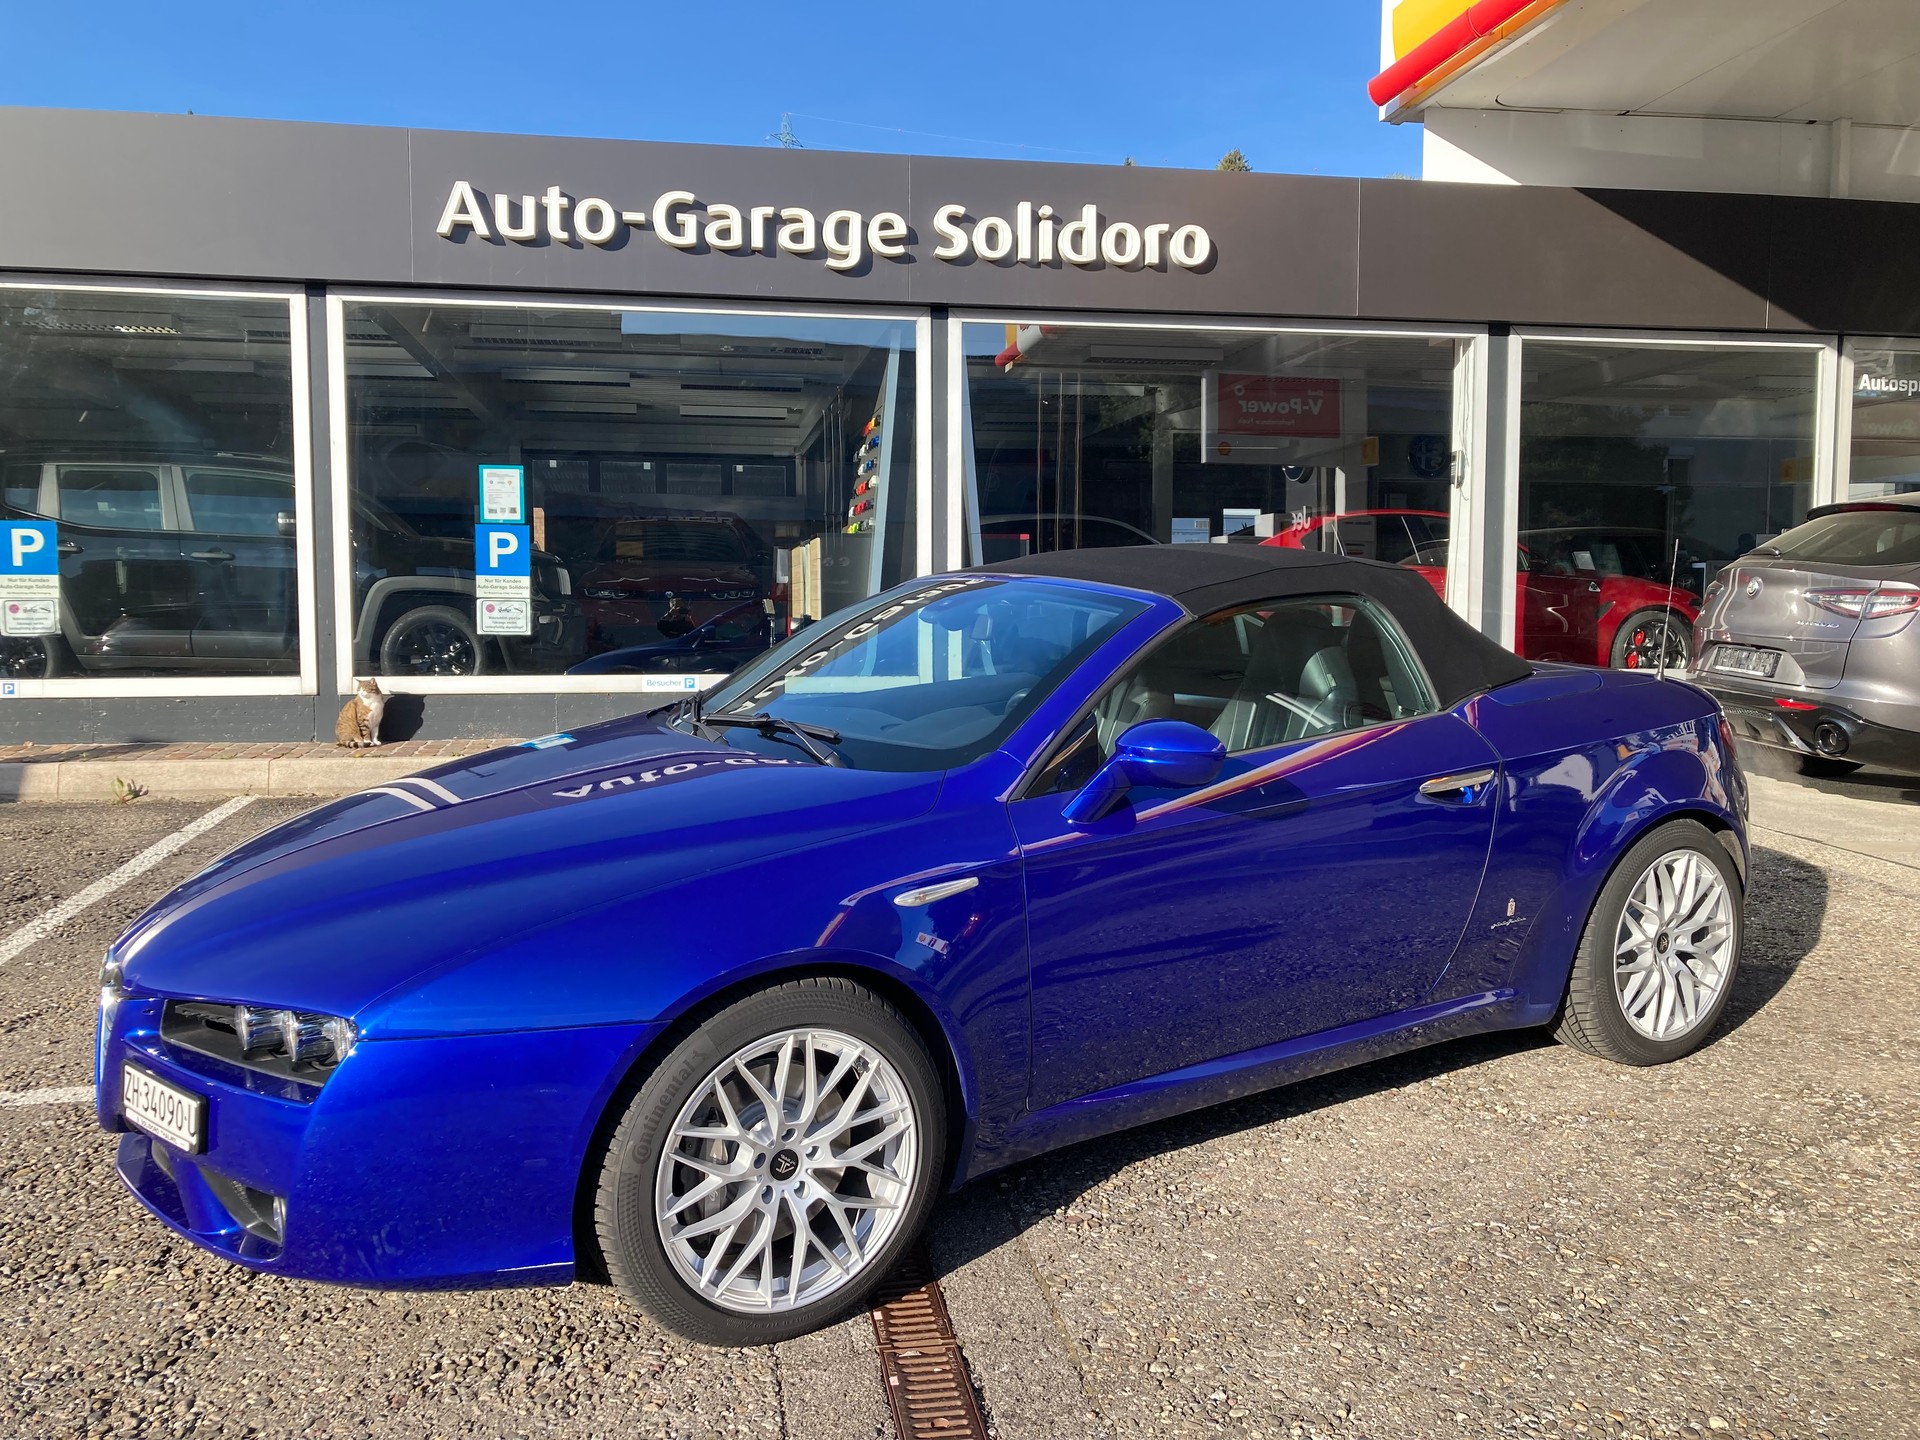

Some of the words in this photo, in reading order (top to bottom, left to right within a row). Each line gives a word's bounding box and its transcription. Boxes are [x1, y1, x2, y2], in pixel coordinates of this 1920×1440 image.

[436, 180, 908, 270] Auto-Garage
[933, 201, 1211, 269] Solidoro
[10, 528, 45, 567] P
[489, 531, 519, 568] P
[646, 679, 682, 687] Besucher
[631, 1058, 697, 1165] Continental
